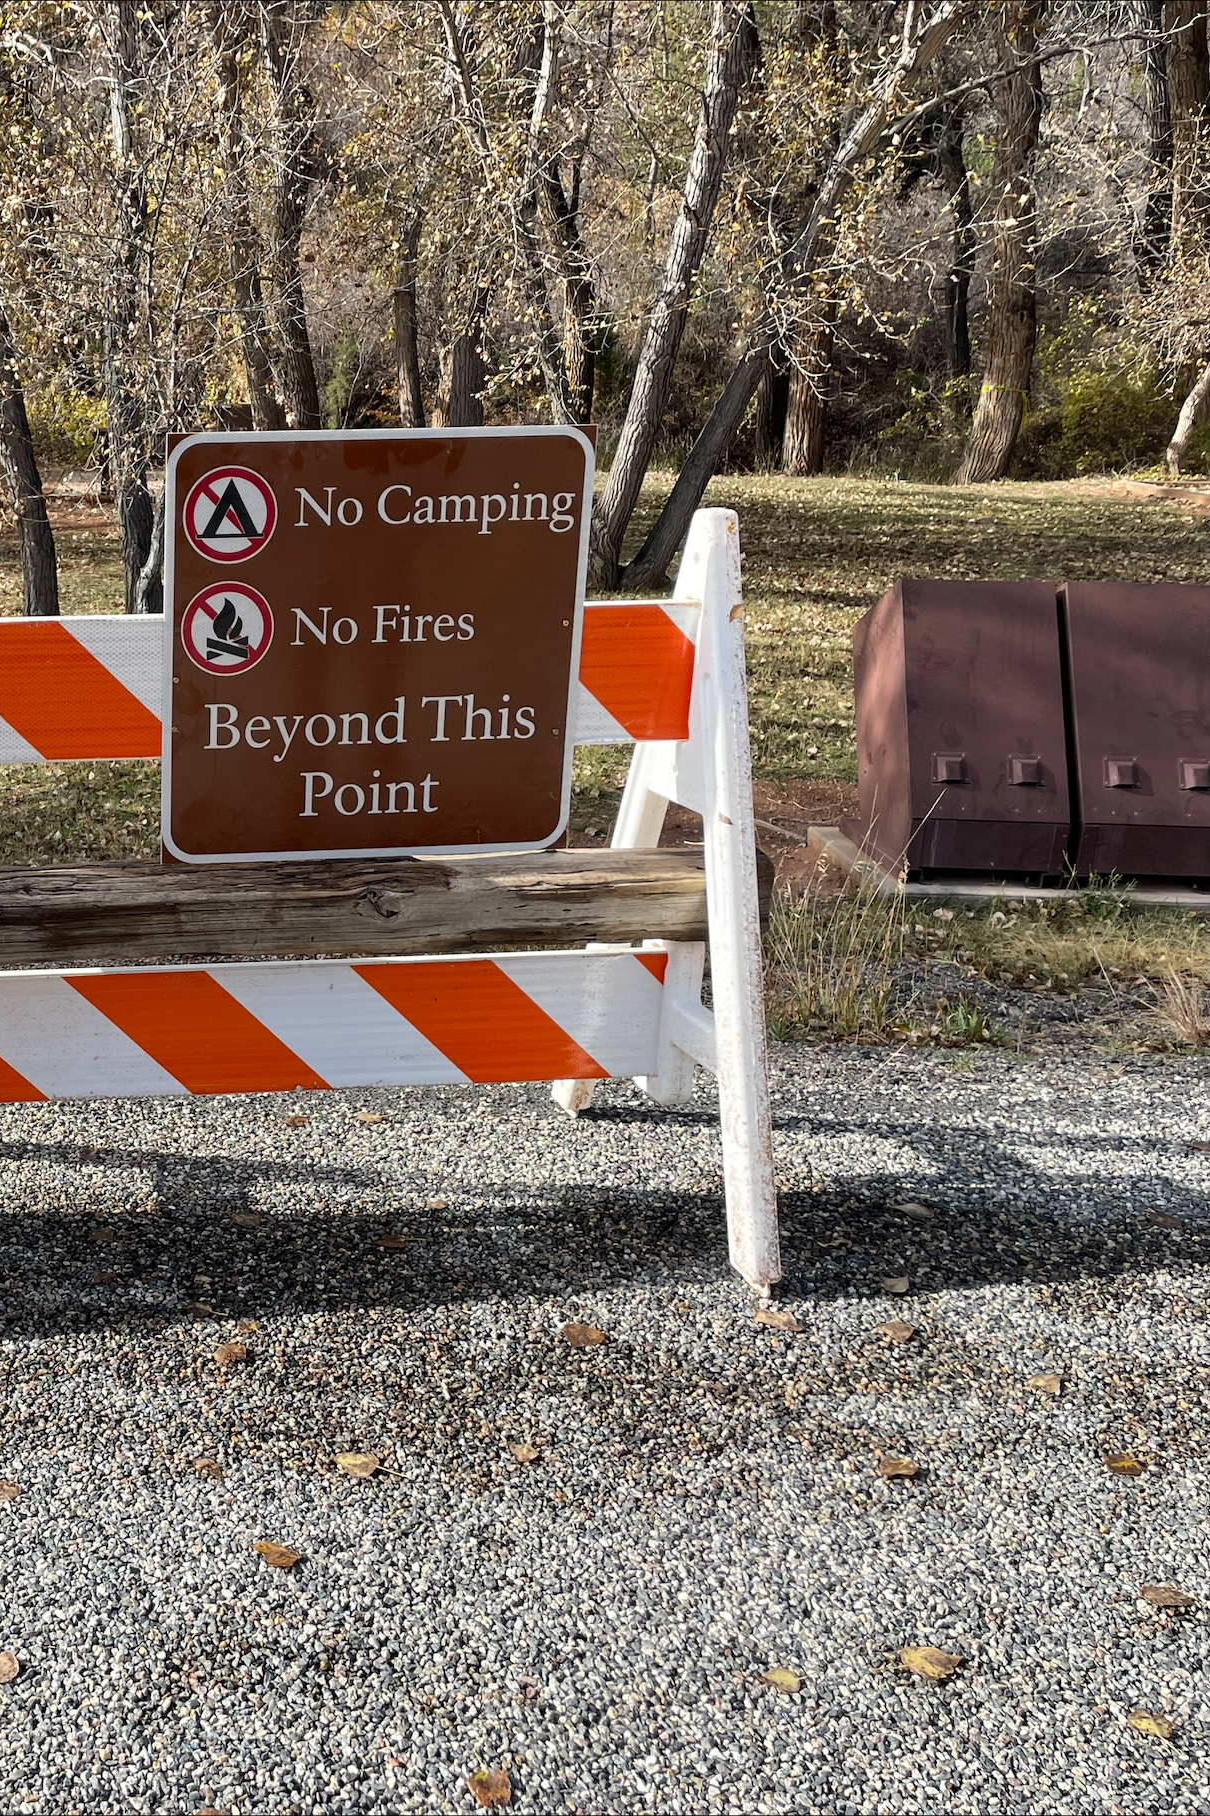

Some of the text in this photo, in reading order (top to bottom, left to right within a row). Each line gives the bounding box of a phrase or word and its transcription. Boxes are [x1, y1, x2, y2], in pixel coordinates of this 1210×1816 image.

[294, 482, 576, 535] No Camping
[290, 604, 475, 646] No Fires
[203, 693, 536, 763] Beyond This
[298, 769, 440, 817] Point
